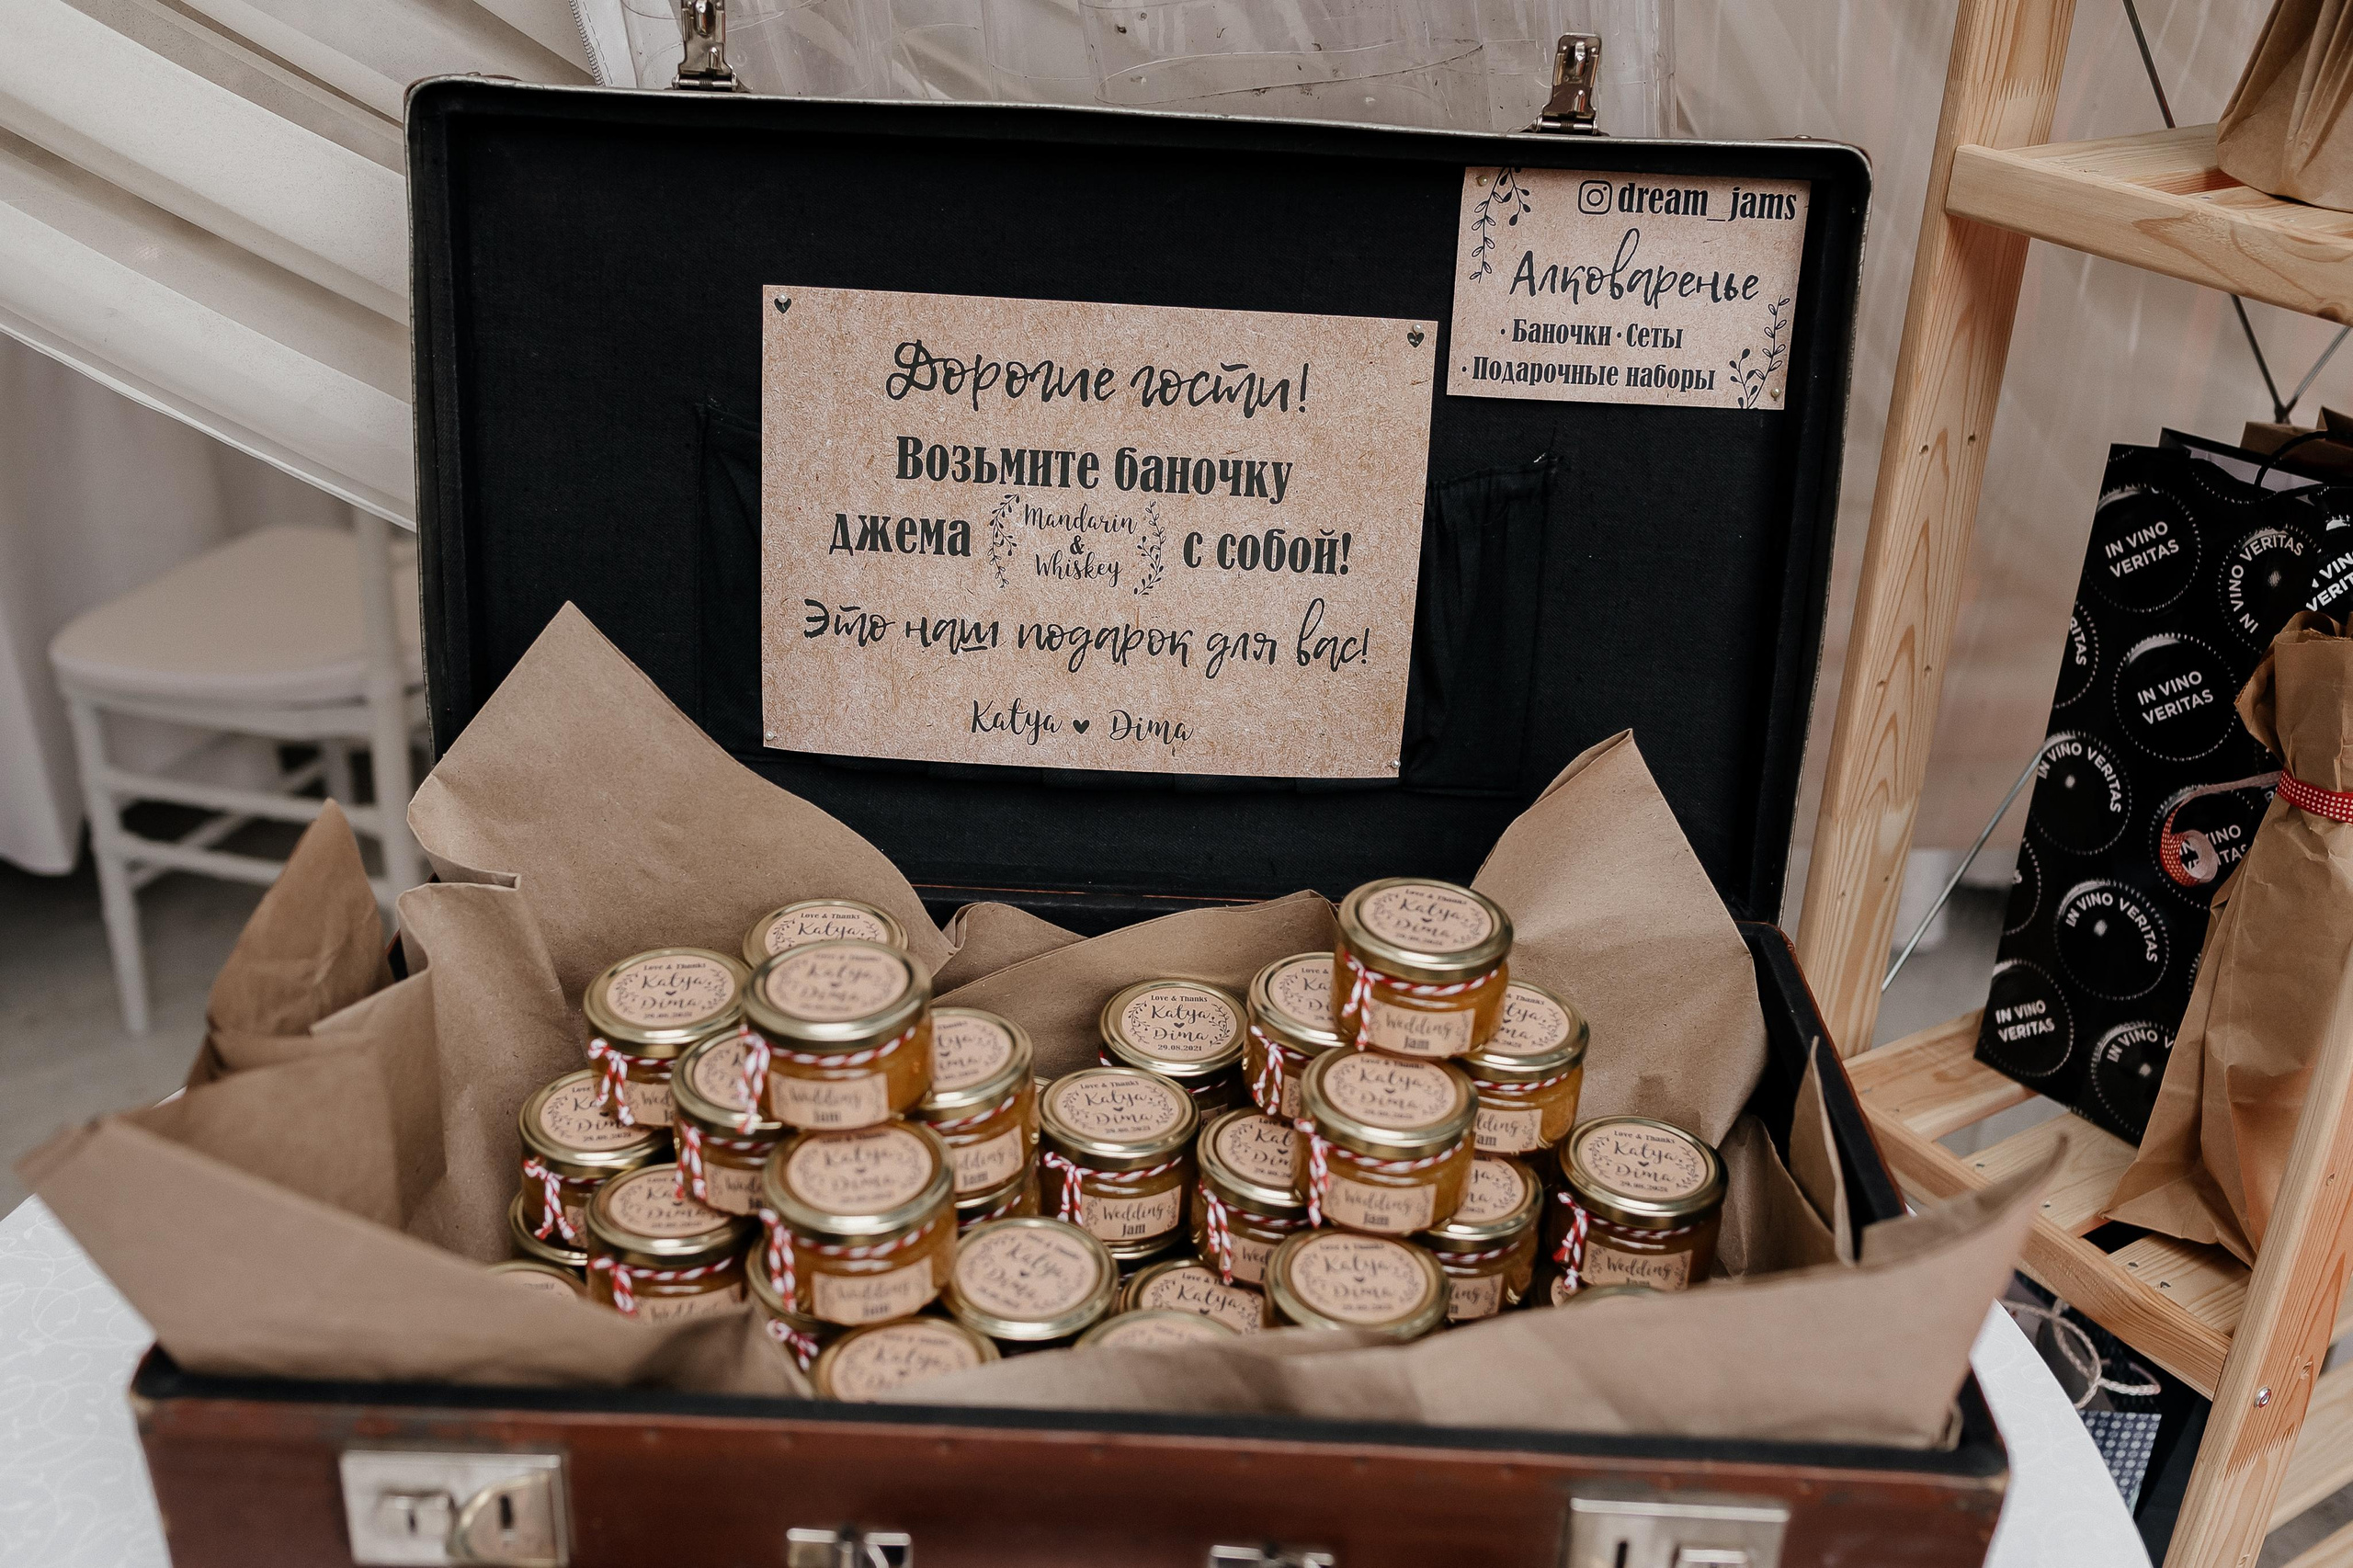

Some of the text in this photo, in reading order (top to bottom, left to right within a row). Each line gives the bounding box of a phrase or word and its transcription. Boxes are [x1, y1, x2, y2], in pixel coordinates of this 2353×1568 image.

[1618, 182, 1797, 222] dream_jams
[1509, 228, 1759, 309] Алковаренье
[1512, 319, 1683, 349] Баночки Сеты
[886, 339, 1310, 418] Дорогие гости!
[1472, 356, 1715, 392] Подарочные наборы
[895, 435, 1293, 505] Возьмите баночку
[1024, 503, 1138, 536] Mandarin
[829, 512, 972, 556] джема
[2105, 520, 2169, 559] IN VINO
[1069, 537, 1085, 555] &
[1183, 529, 1352, 575] с собой!
[2109, 539, 2180, 578] VERITAS
[2319, 551, 2353, 579] VIN
[1034, 553, 1122, 588] Whiskey
[2229, 535, 2303, 634] IN VINO VERITAS
[2306, 571, 2353, 611] VERIT
[803, 598, 1370, 679] Это наш подарок для вас!
[2070, 617, 2087, 665] RITAS
[2137, 671, 2202, 706] IN VINO
[2142, 689, 2214, 725] VERITAS
[971, 699, 1194, 745] Katya Dima
[2038, 742, 2121, 812] IN VINO VERITAS
[2206, 824, 2241, 845] INO
[1399, 898, 1461, 919] Katya
[798, 921, 858, 939] Katya
[1394, 918, 1454, 938] Dima
[2065, 892, 2158, 963] IN VINO VERITAS
[641, 971, 705, 994] Katya
[641, 994, 697, 1010] Dima
[1180, 994, 1209, 1003] Thanks
[1152, 1004, 1211, 1022] Katya
[1995, 1000, 2046, 1024] IN VINO
[1153, 1028, 1208, 1042] Dima
[1385, 1015, 1453, 1038] Wedding
[1997, 1017, 2055, 1043] VERITAS
[1157, 1044, 1202, 1052] 29.08.2021
[1404, 1038, 1429, 1051] Jam
[2117, 1029, 2158, 1050] VINO
[1083, 1091, 1149, 1108] Katya
[1096, 1112, 1154, 1126] Dima
[1255, 1129, 1292, 1147] Kat
[1475, 1133, 1497, 1147] am
[1614, 1130, 1632, 1139] Love
[1644, 1133, 1676, 1144] Thanks
[1253, 1150, 1290, 1165] Dim
[1613, 1141, 1676, 1164] Katya
[1615, 1165, 1676, 1183] Dima
[1102, 1203, 1165, 1222] Wedding
[1121, 1222, 1146, 1238] Jam
[1607, 1257, 1672, 1280] Wedding
[1176, 1285, 1239, 1311] Katya
